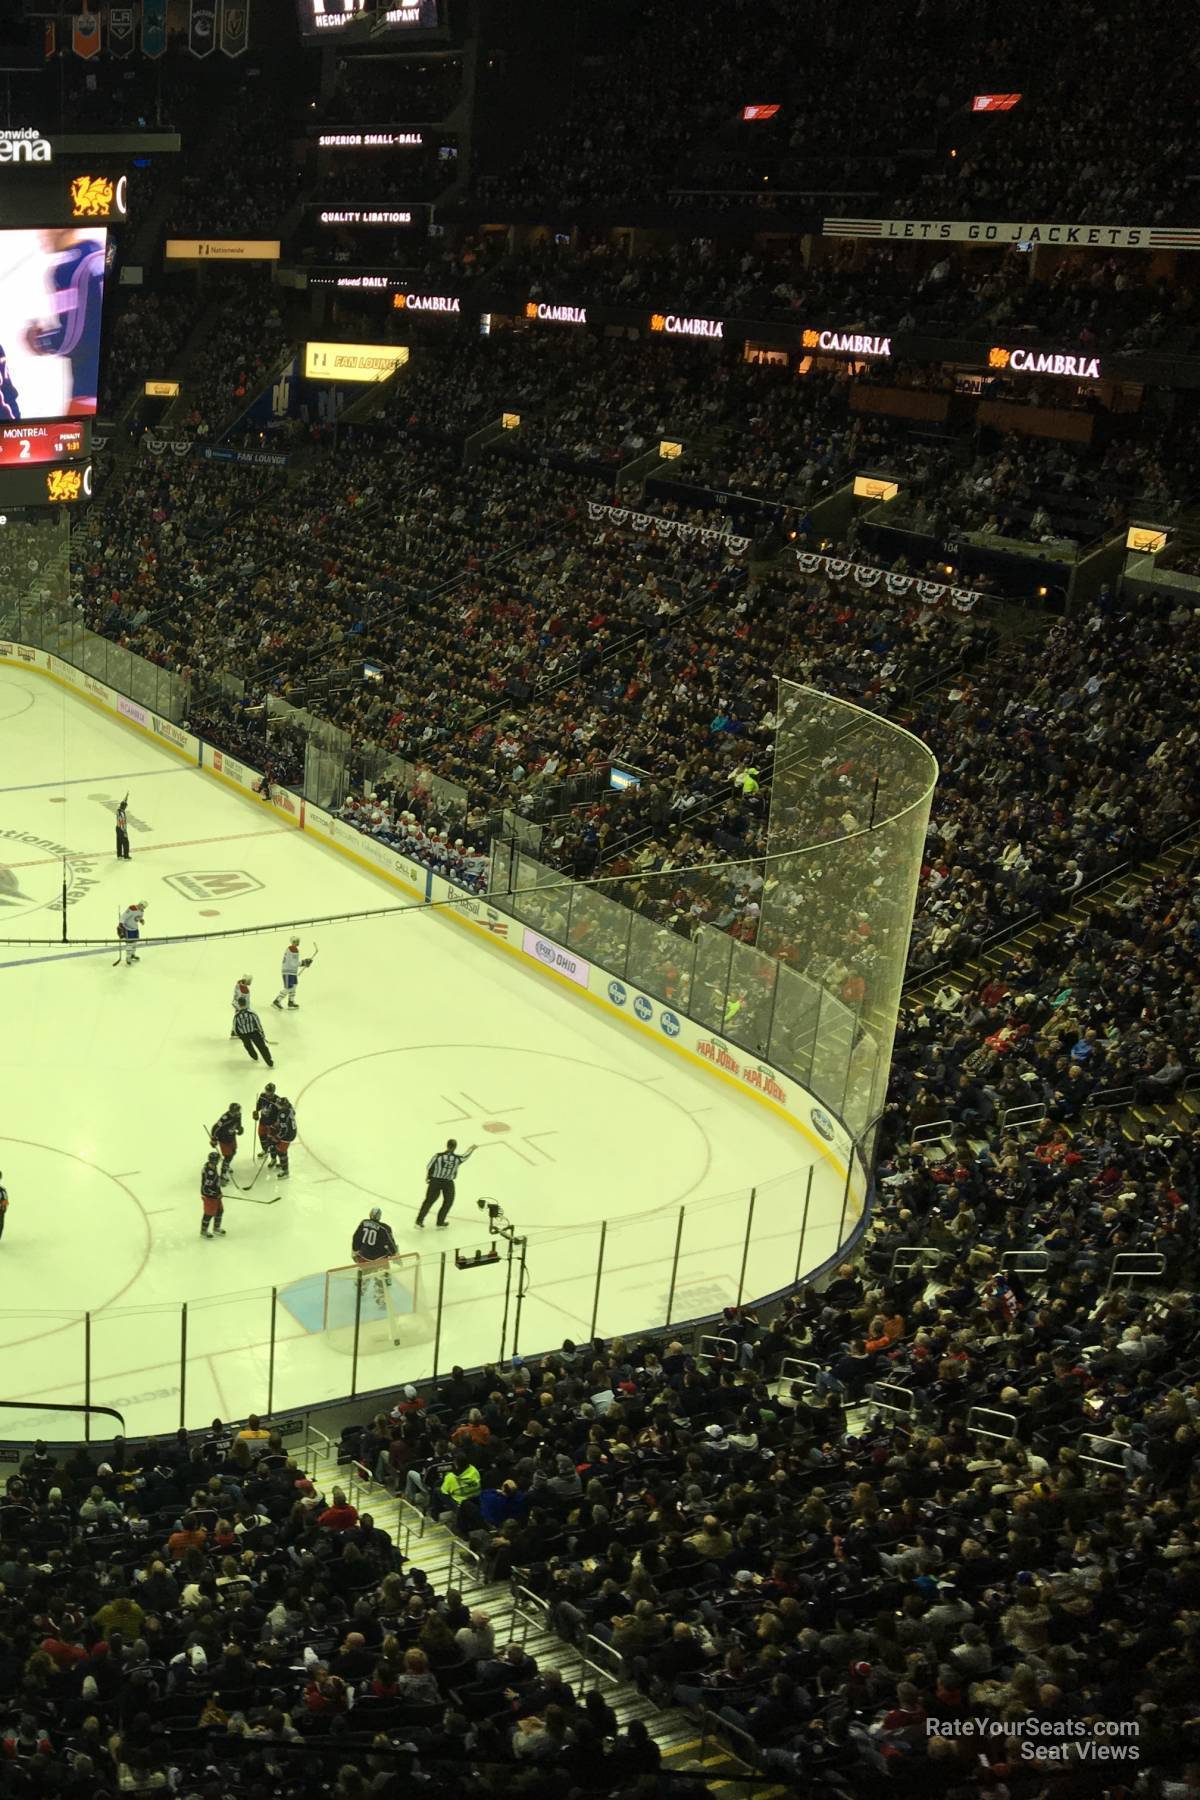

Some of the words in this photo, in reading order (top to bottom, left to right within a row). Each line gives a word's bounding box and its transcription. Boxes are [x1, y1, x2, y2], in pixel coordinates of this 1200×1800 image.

[319, 135, 362, 146] SUPERIOR
[364, 133, 422, 145] SMALL-BALL
[321, 211, 360, 223] QUALITY
[363, 211, 411, 223] LIBATIONS
[889, 223, 951, 238] LET'S
[968, 225, 997, 240] GO
[1011, 226, 1141, 245] JACKETS
[362, 277, 389, 287] DAILY
[406, 294, 460, 313] CAMBRIA
[537, 303, 586, 322] CAMBRIA
[664, 314, 724, 338] CAMBRIA
[818, 329, 892, 356] CAMBRIA
[334, 355, 357, 368] FAN
[1010, 349, 1101, 379] CAMBRIA
[3, 427, 49, 439] MONTREAL
[19, 440, 31, 459] 2
[556, 953, 577, 974] OHIO
[362, 1228, 377, 1246] 70
